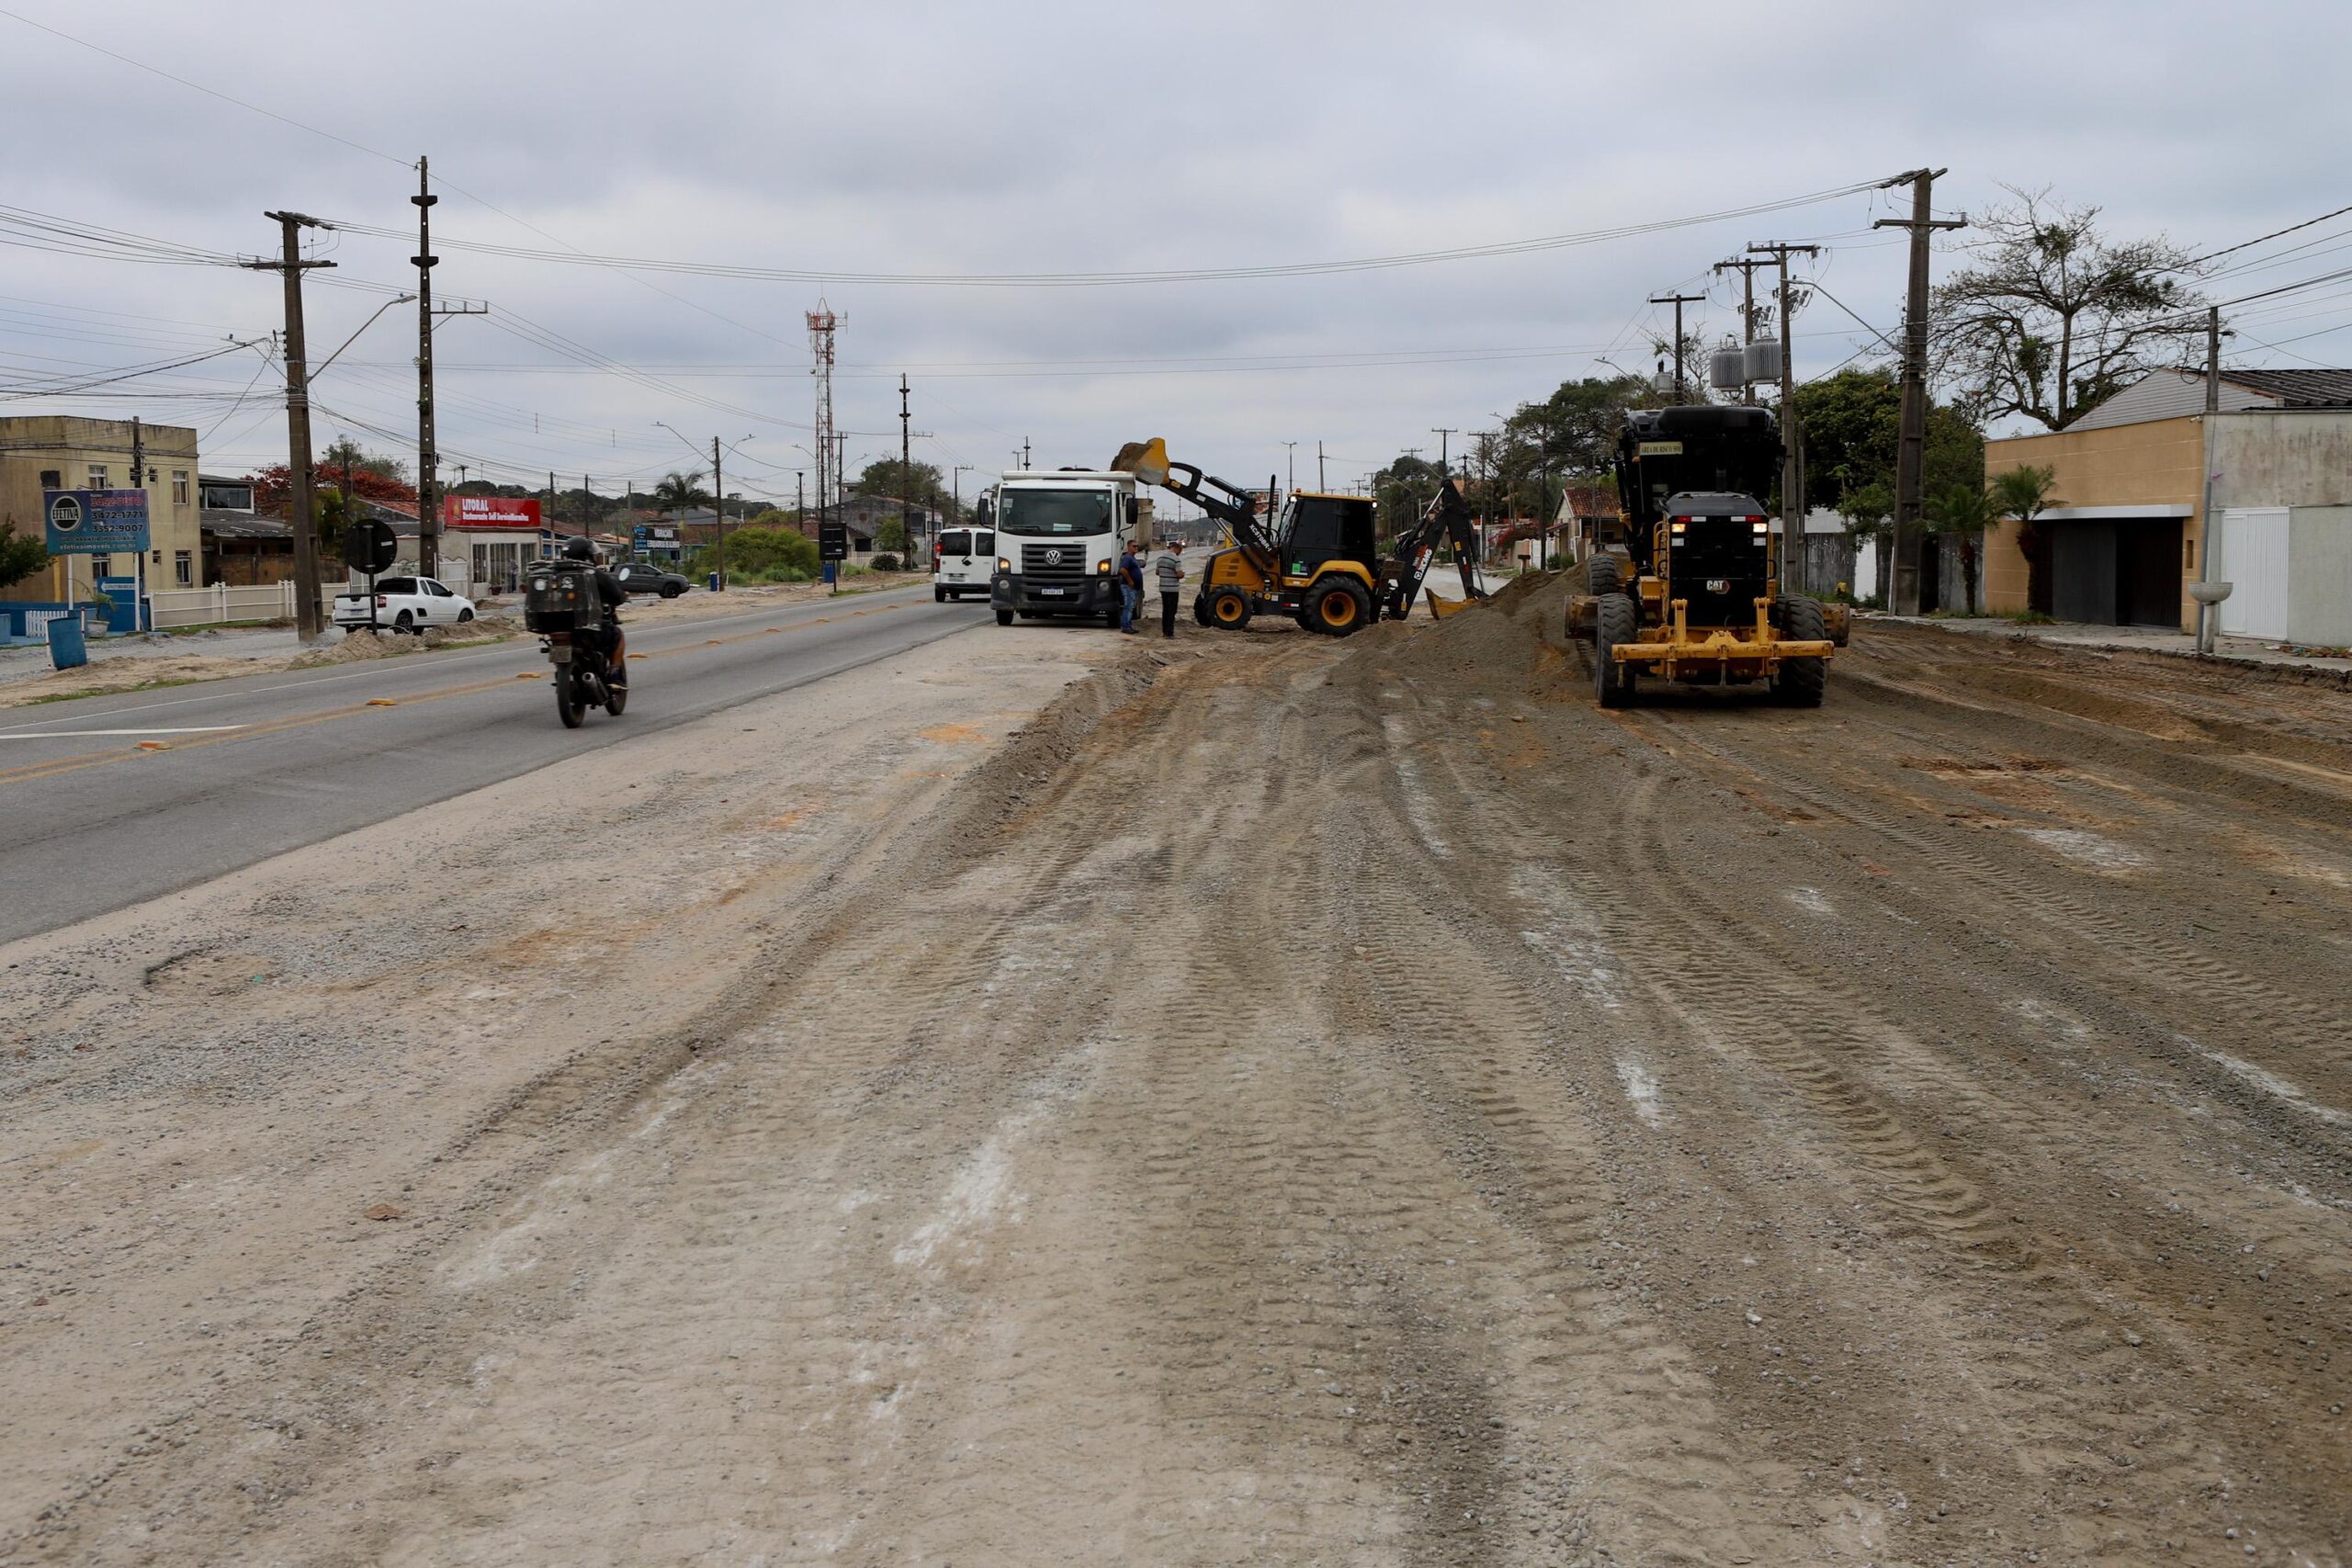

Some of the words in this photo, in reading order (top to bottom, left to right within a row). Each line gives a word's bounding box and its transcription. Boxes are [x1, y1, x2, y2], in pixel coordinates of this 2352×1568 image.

[462, 499, 489, 512] LITORAL
[52, 508, 79, 519] EFETIVA
[92, 511, 143, 520] 3472-1771
[1418, 548, 1432, 573] XCMG
[1706, 580, 1724, 591] CAT
